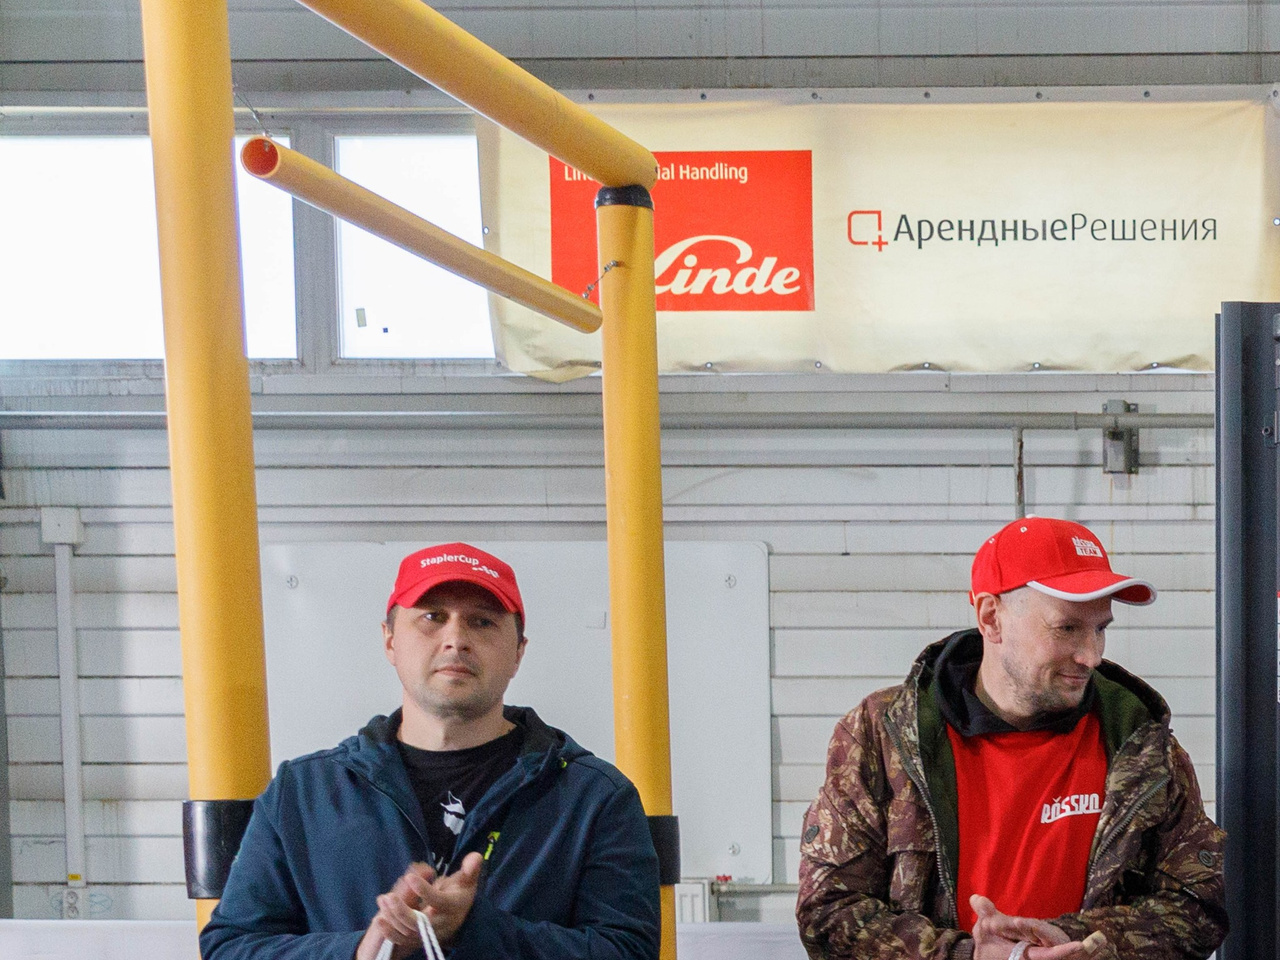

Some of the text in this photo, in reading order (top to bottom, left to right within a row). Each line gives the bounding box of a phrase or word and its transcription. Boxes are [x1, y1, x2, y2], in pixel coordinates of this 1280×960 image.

[679, 162, 748, 184] Handling
[893, 213, 1218, 249] АрендныеРешения
[654, 234, 801, 296] Linde
[420, 554, 480, 568] StaplerCup
